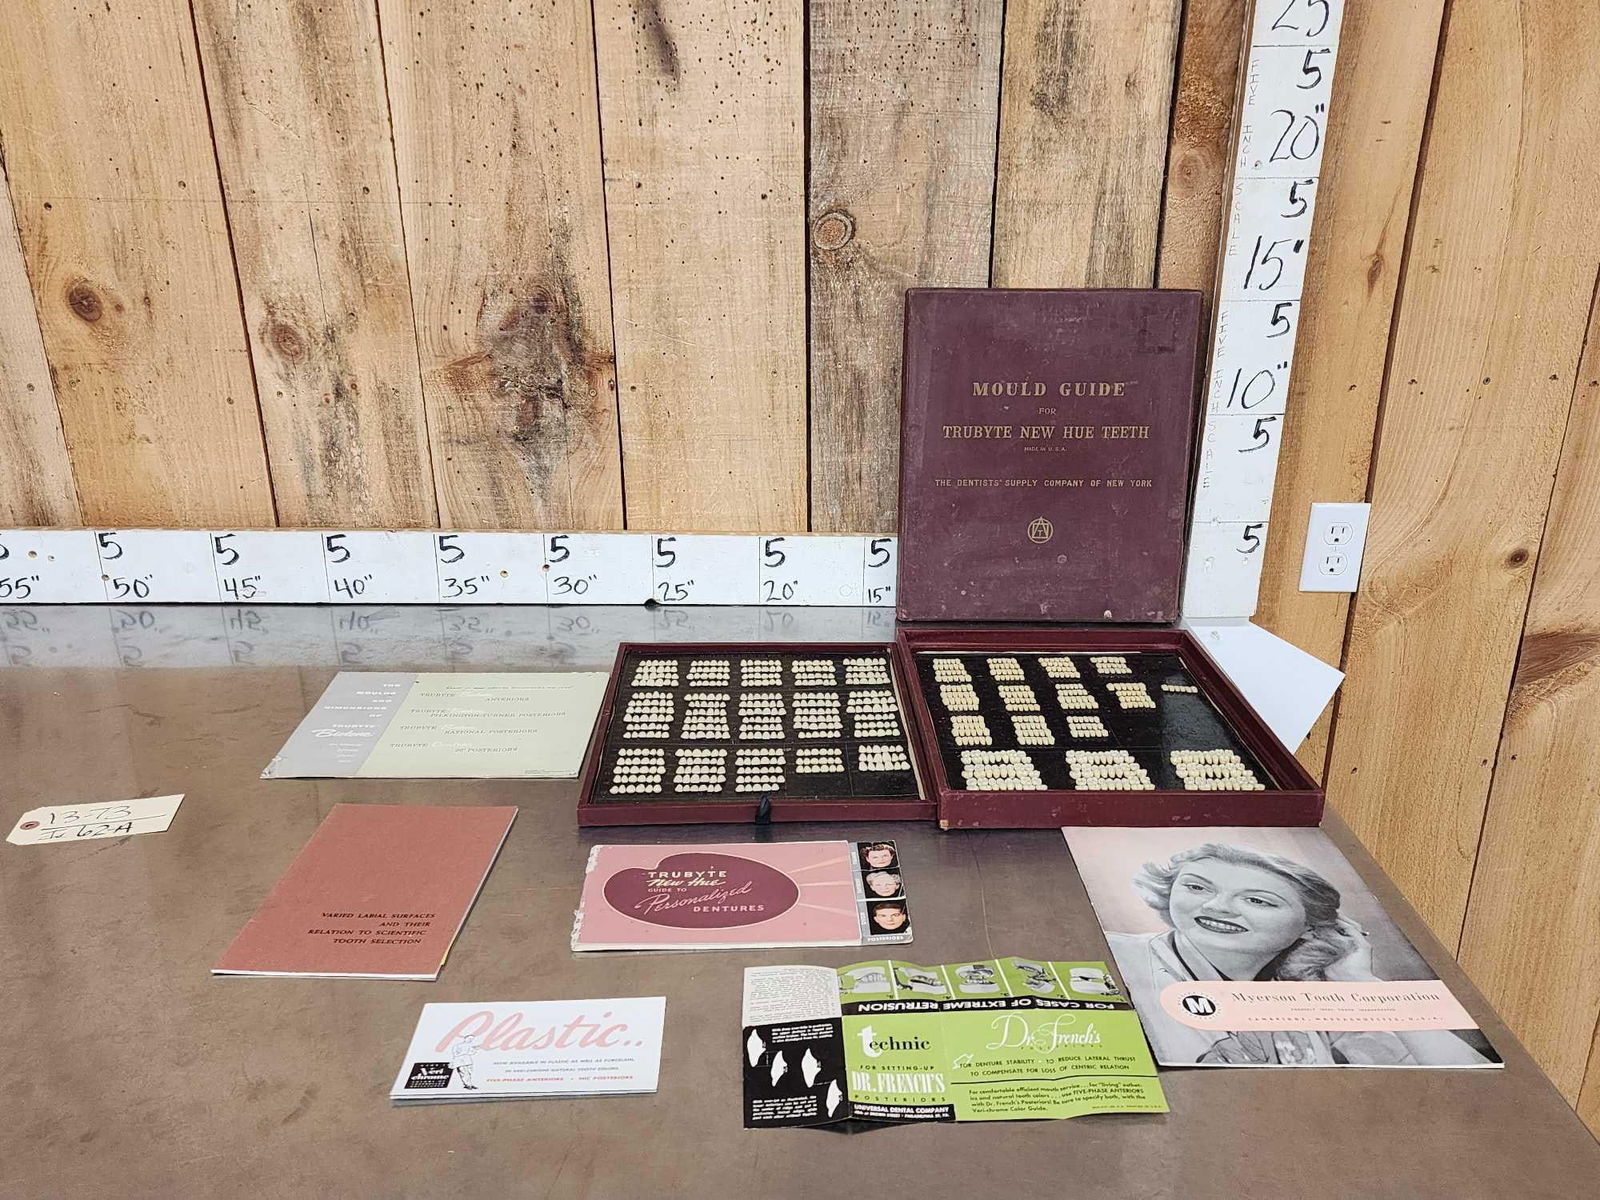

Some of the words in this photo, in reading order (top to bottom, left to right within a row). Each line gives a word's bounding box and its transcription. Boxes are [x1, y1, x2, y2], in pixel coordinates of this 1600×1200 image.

[1296, 48, 1331, 89] 5
[1269, 103, 1325, 163] 20"
[1281, 179, 1314, 218] 5
[1266, 302, 1292, 338] 5
[972, 382, 1047, 397] MOULD
[1059, 382, 1126, 397] GUIDE
[1227, 361, 1288, 409] 10"
[1038, 407, 1057, 415] FOR
[942, 426, 1012, 439] TRUBYTE
[1020, 426, 1055, 439] NEW
[1063, 426, 1094, 439] HUE
[1102, 426, 1151, 439] TEETH
[1238, 416, 1277, 453] 5
[935, 479, 952, 487] THE
[957, 479, 1002, 487] DENTISTS'
[1004, 479, 1038, 487] SUPPLY
[1044, 479, 1084, 488] COMPANY
[1091, 479, 1101, 487] OF
[1107, 479, 1124, 487] NEW
[1130, 479, 1152, 487] YORK
[98, 532, 123, 560] 5
[215, 533, 240, 565] 5
[326, 534, 351, 563] 5
[438, 534, 465, 564] 5
[549, 534, 571, 563] 5
[1236, 523, 1263, 554] 5
[655, 537, 677, 568] 5
[764, 537, 786, 568] 5
[868, 538, 892, 568] 5
[113, 574, 153, 599] 50"
[223, 575, 261, 600] 45"
[334, 574, 373, 599] 40"
[443, 575, 491, 599] 35"
[553, 574, 598, 596] 30"
[657, 579, 695, 602] 25"
[763, 579, 799, 602] 20"
[867, 585, 892, 604] 15"
[645, 878, 685, 887] New
[686, 877, 727, 887] Hue
[648, 870, 727, 878] TRUBYTE
[634, 881, 753, 915] Personalized
[693, 904, 765, 913] DENTURES
[859, 1001, 939, 1012] RETRUSION
[943, 1001, 1007, 1011] EXTREME
[1010, 999, 1031, 1008] OF
[1037, 999, 1079, 1009] CASES
[1185, 997, 1214, 1013] M
[1232, 992, 1297, 1003] Myerson
[1300, 992, 1345, 1002] Tooth
[1350, 992, 1440, 1004] Corporation
[857, 1025, 931, 1058] technic
[975, 1060, 1002, 1068] DENTURE
[982, 1068, 1024, 1076] COMPENSATE
[852, 1071, 877, 1092] DR.
[877, 1072, 945, 1093] FRENCH'S
[854, 1094, 946, 1102] POSTERIORS
[854, 1104, 889, 1112] UNIVERSAL
[915, 1106, 949, 1114] COMPANY
